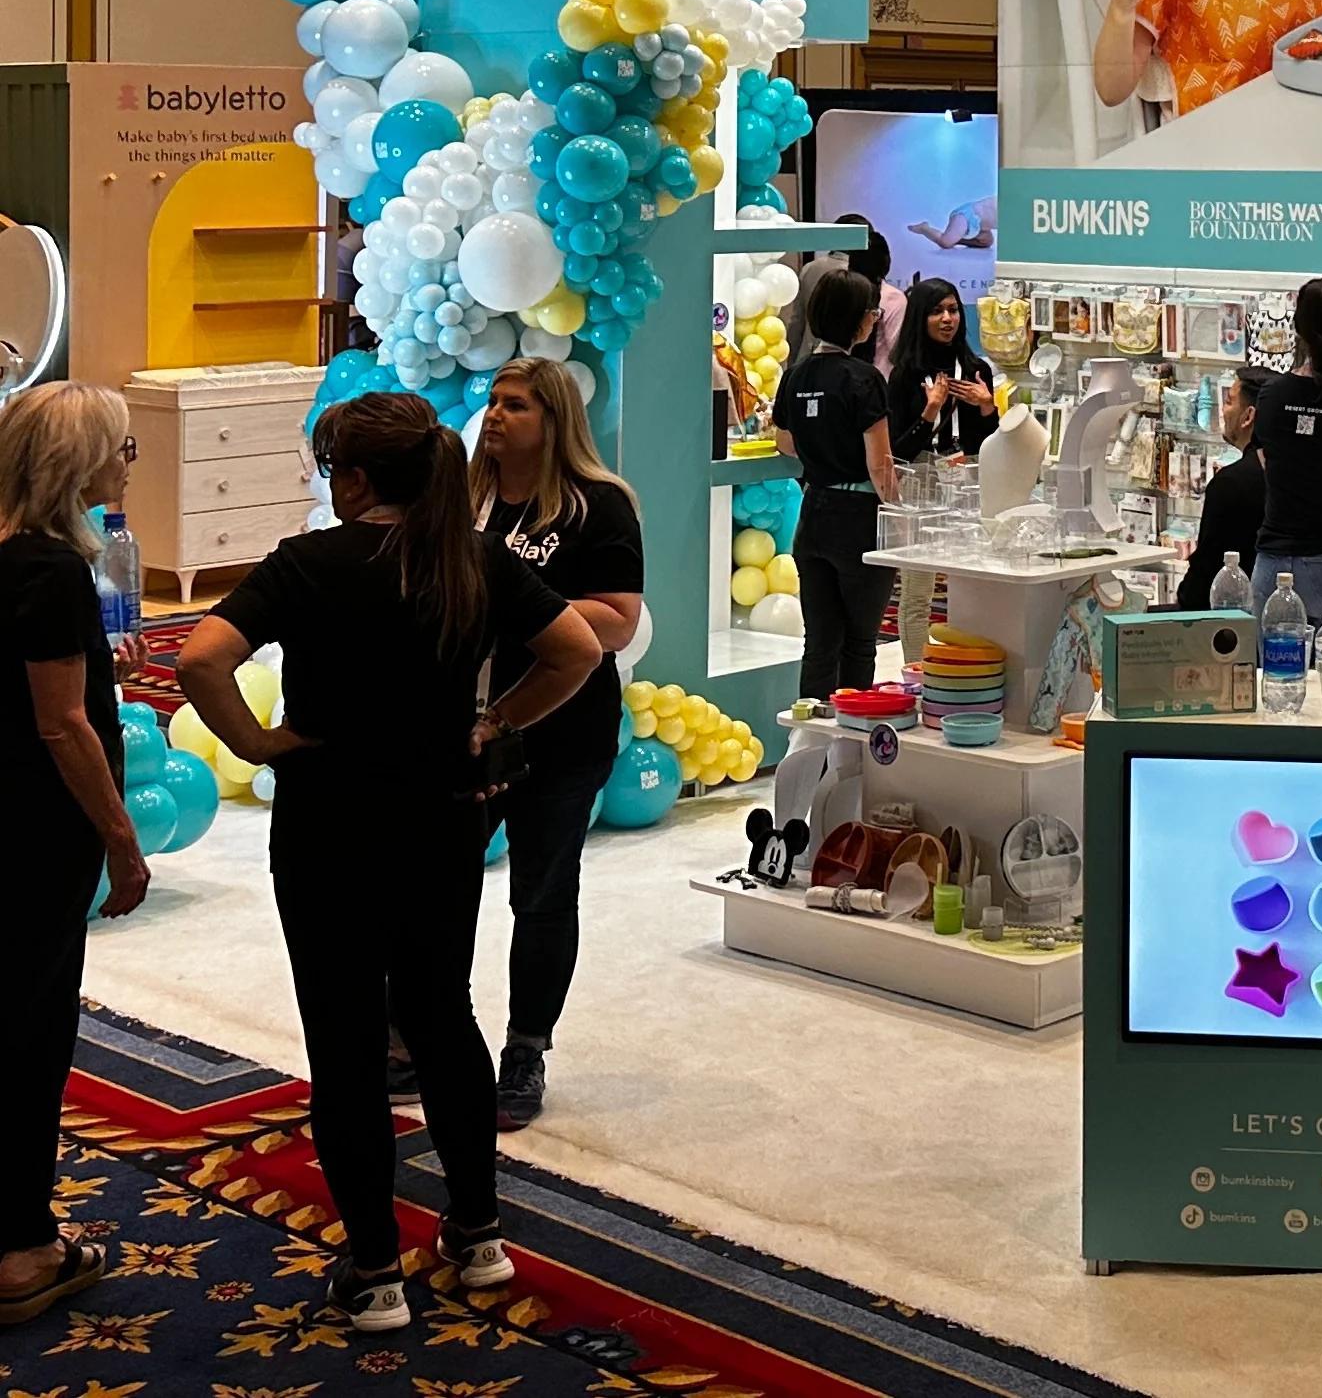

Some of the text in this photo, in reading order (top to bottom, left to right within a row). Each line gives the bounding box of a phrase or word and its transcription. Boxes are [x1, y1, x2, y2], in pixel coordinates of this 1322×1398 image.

[147, 84, 286, 115] babyletto
[117, 130, 153, 143] Make
[202, 130, 227, 143] first
[231, 130, 255, 143] bed
[259, 131, 287, 143] with
[129, 150, 151, 162] the
[155, 150, 196, 165] things
[200, 150, 227, 162] that
[1189, 220, 1314, 242] FOUNDATION
[1232, 1113, 1304, 1136] LET'S
[1220, 1173, 1295, 1191] bumkinsbaby
[1209, 1210, 1256, 1225] bumkins
